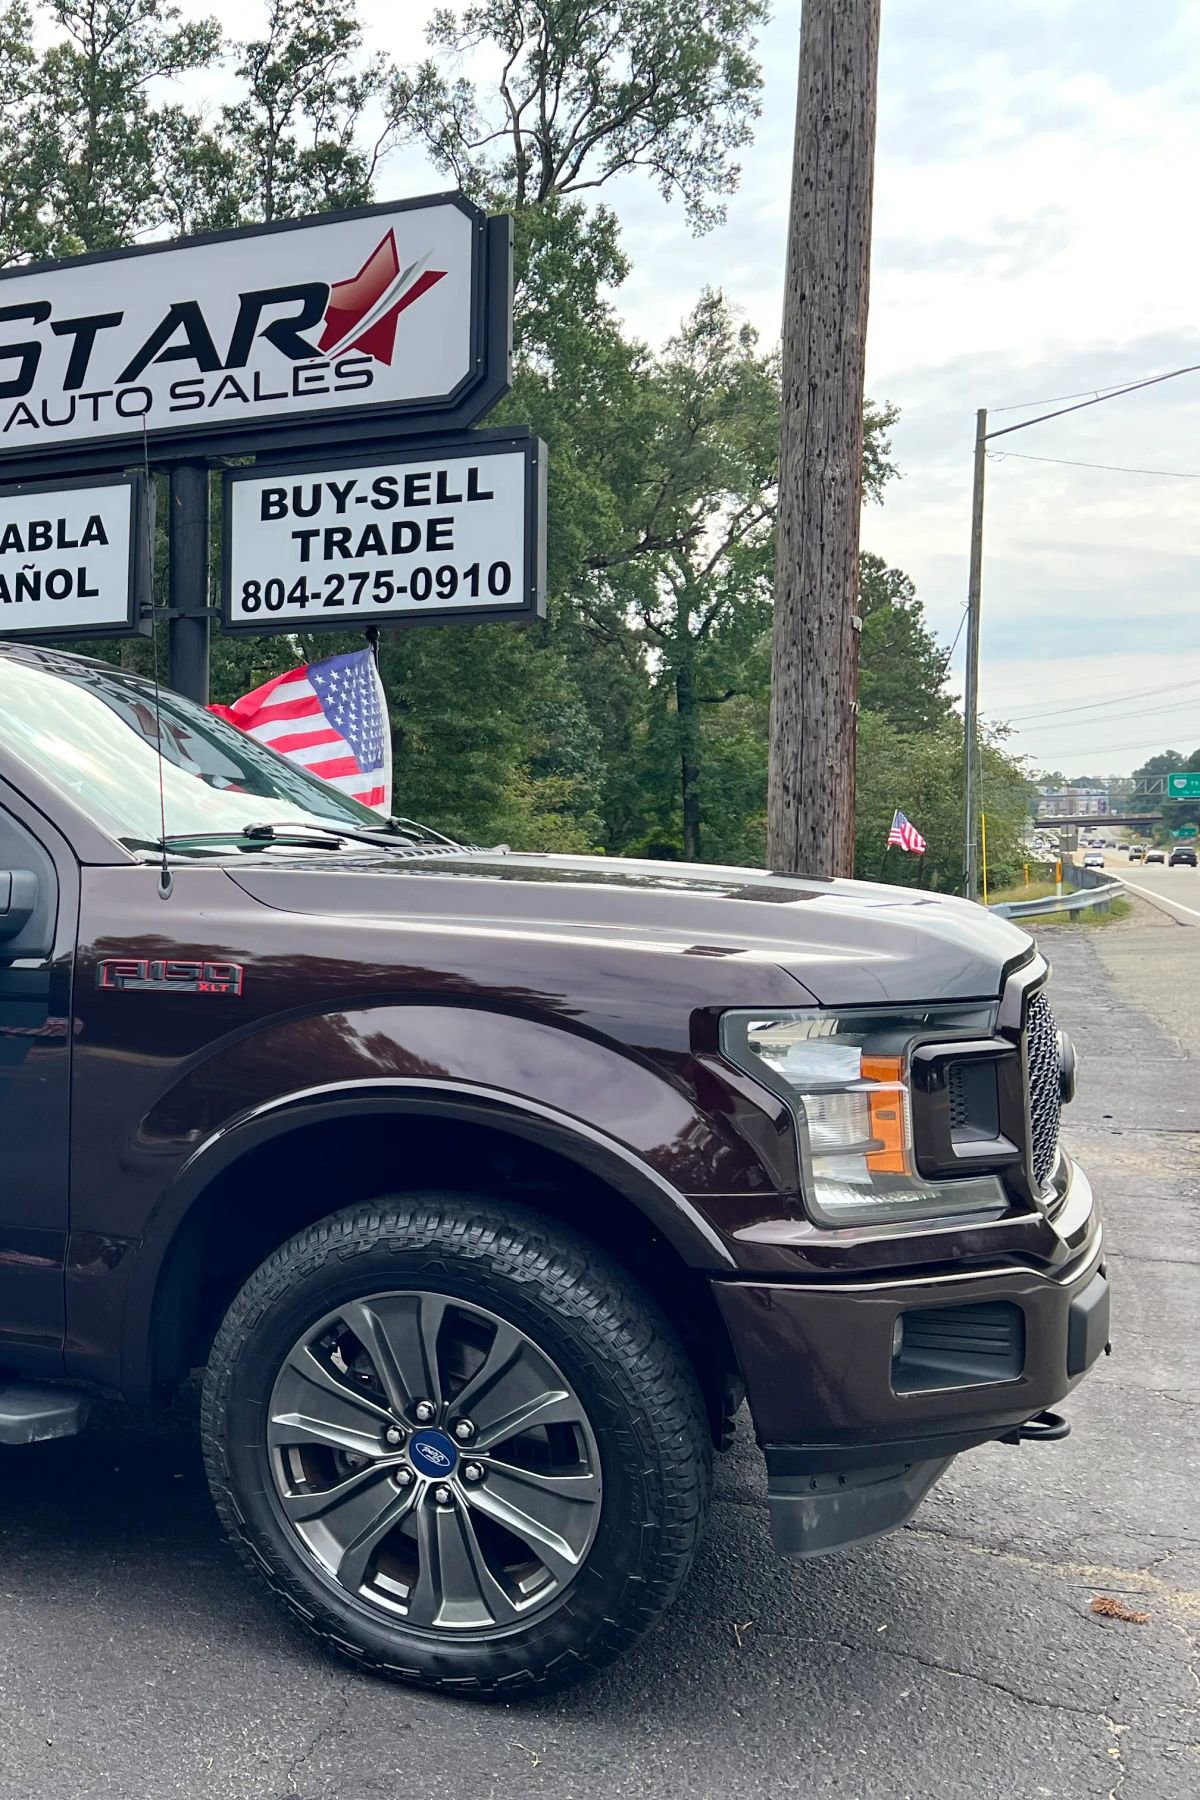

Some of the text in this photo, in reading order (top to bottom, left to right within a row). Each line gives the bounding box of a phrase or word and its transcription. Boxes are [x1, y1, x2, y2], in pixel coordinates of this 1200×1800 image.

[3, 356, 374, 432] AUTO SALES
[261, 468, 493, 521] BUY-SELL
[292, 517, 454, 562] TRADE
[242, 561, 511, 612] 804-275-0910
[199, 983, 229, 993] XLT
